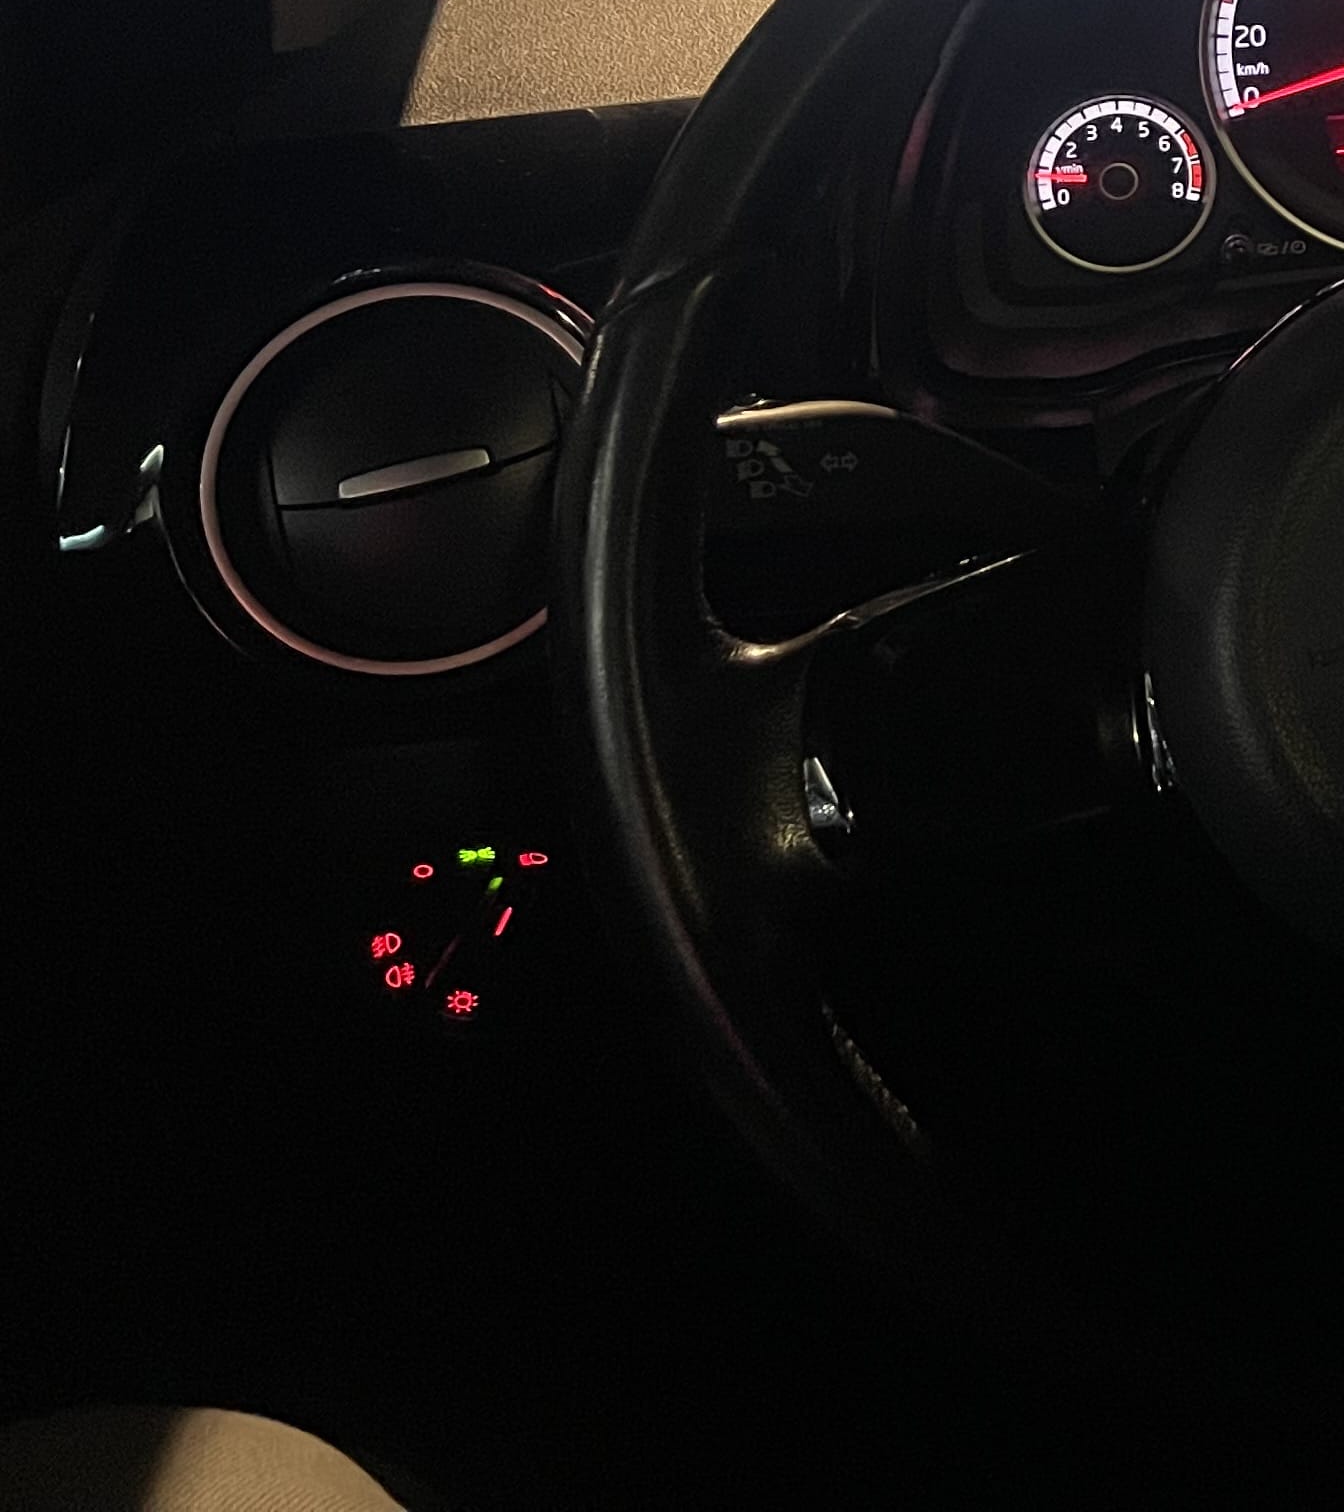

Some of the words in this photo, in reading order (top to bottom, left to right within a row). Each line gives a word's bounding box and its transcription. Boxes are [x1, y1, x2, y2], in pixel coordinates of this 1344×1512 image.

[1234, 24, 1267, 48] 20
[1236, 62, 1271, 77] km/h
[1243, 86, 1260, 109] 0
[1086, 124, 1098, 141] 3
[1110, 116, 1123, 133] 4
[1138, 120, 1150, 138] 5
[1065, 141, 1078, 158] 2
[1158, 135, 1171, 152] 6
[1171, 156, 1184, 174] 7
[1057, 188, 1070, 205] 0
[1171, 182, 1184, 199] 8
